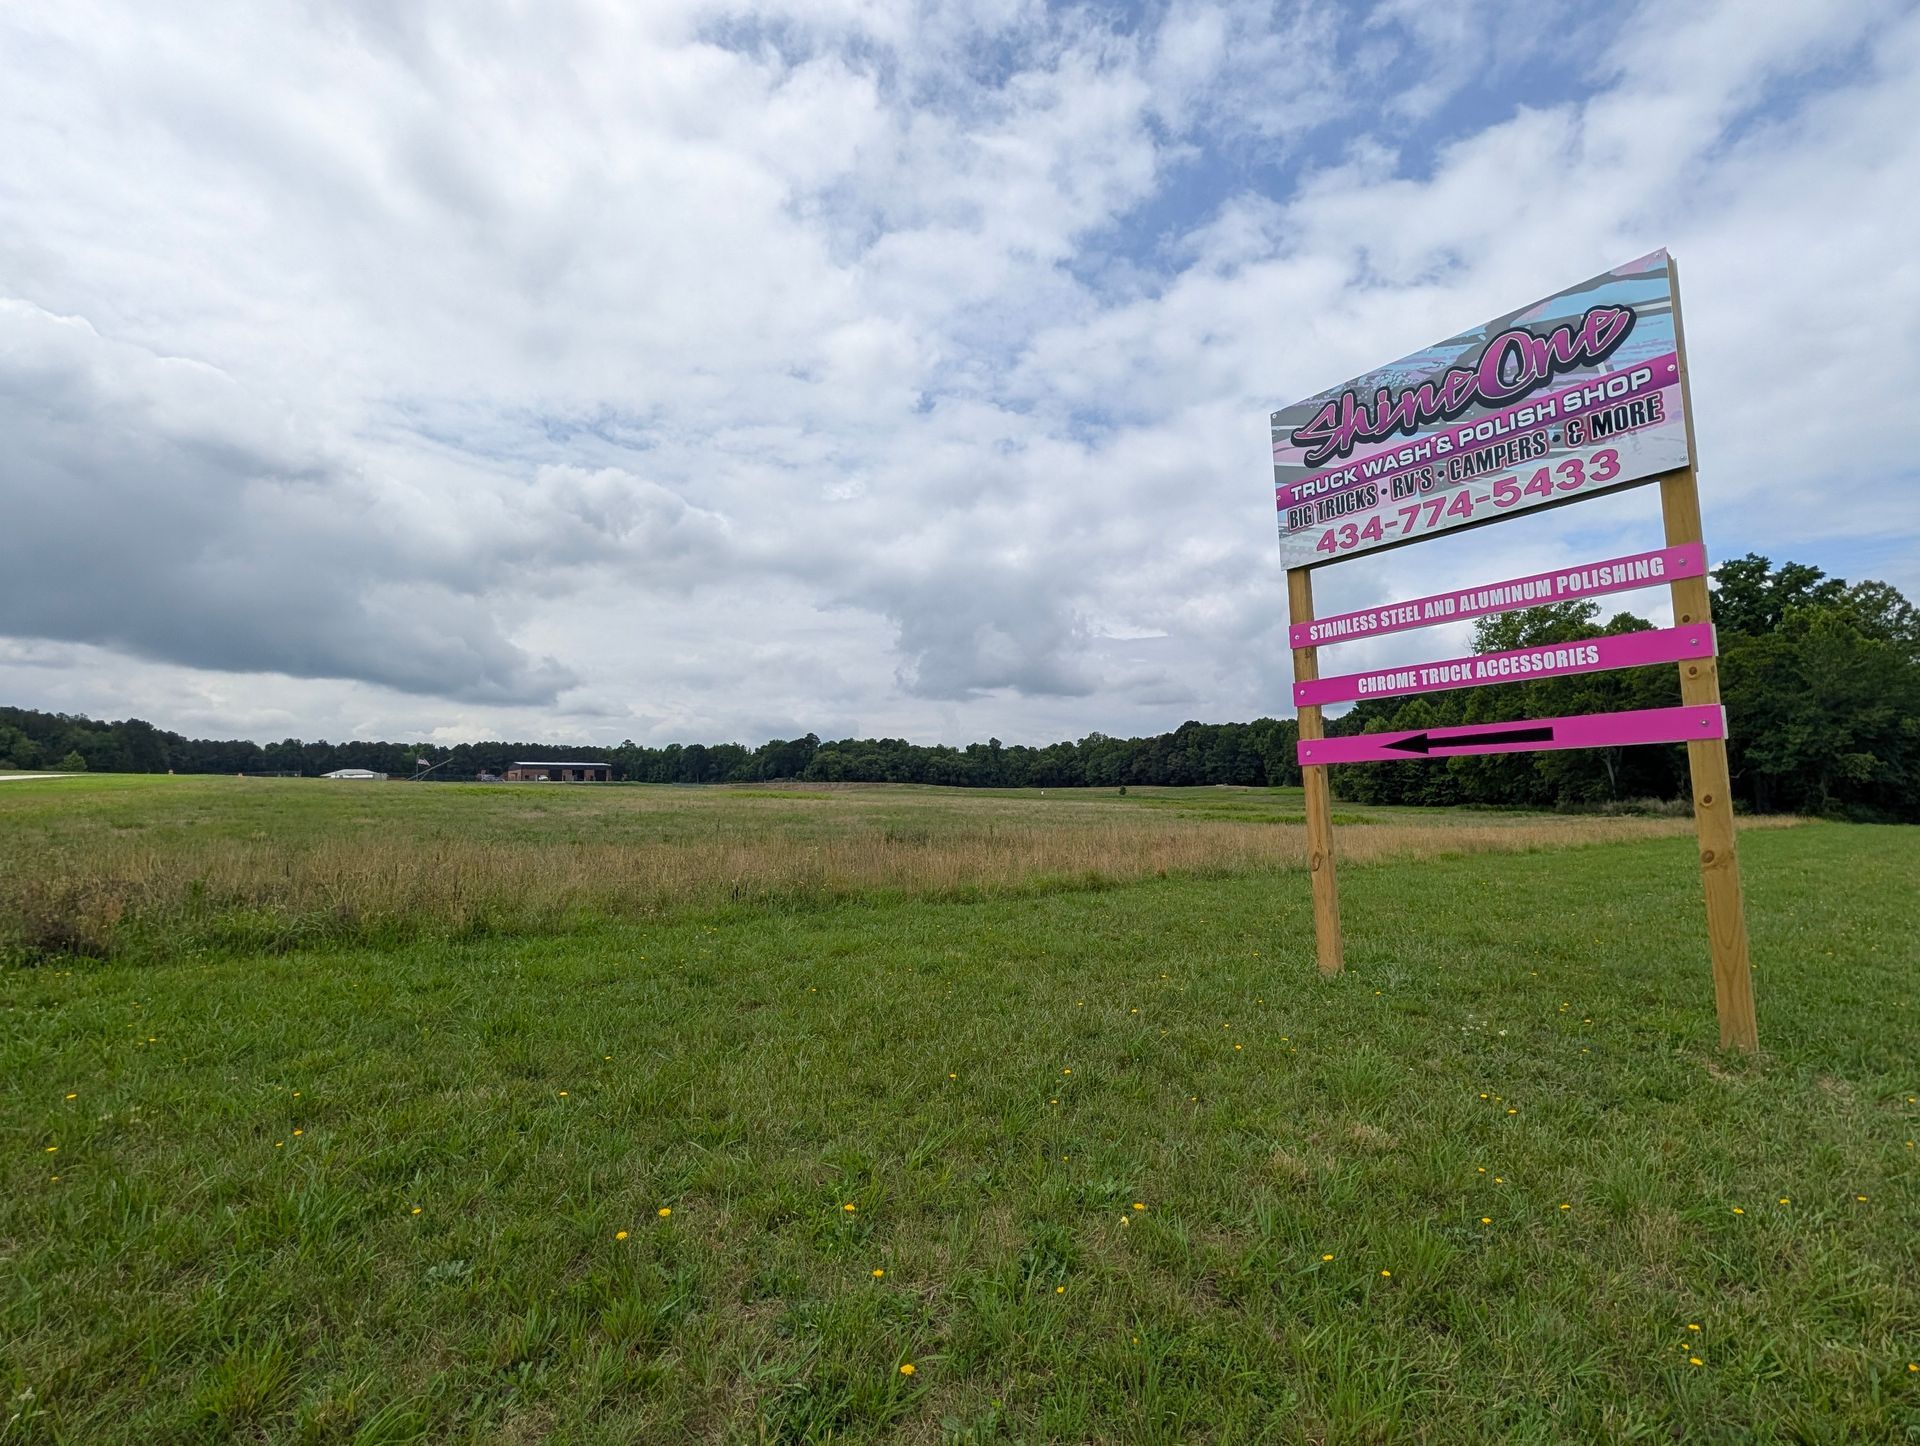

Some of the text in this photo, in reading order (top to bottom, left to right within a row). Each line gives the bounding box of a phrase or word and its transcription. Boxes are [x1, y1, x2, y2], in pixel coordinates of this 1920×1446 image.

[1289, 393, 1664, 530] BIG TRUCKS RV'S CAMPERS & MORE
[1291, 369, 1652, 501] TRUCK WASH & POLISH SHOP
[1316, 449, 1621, 553] 434-774-5433
[1309, 557, 1665, 640] STAINLESS STEEL AND ALUMINUM POLISHING
[1358, 646, 1599, 694] CHROME TRUCK ACCESSORIES
